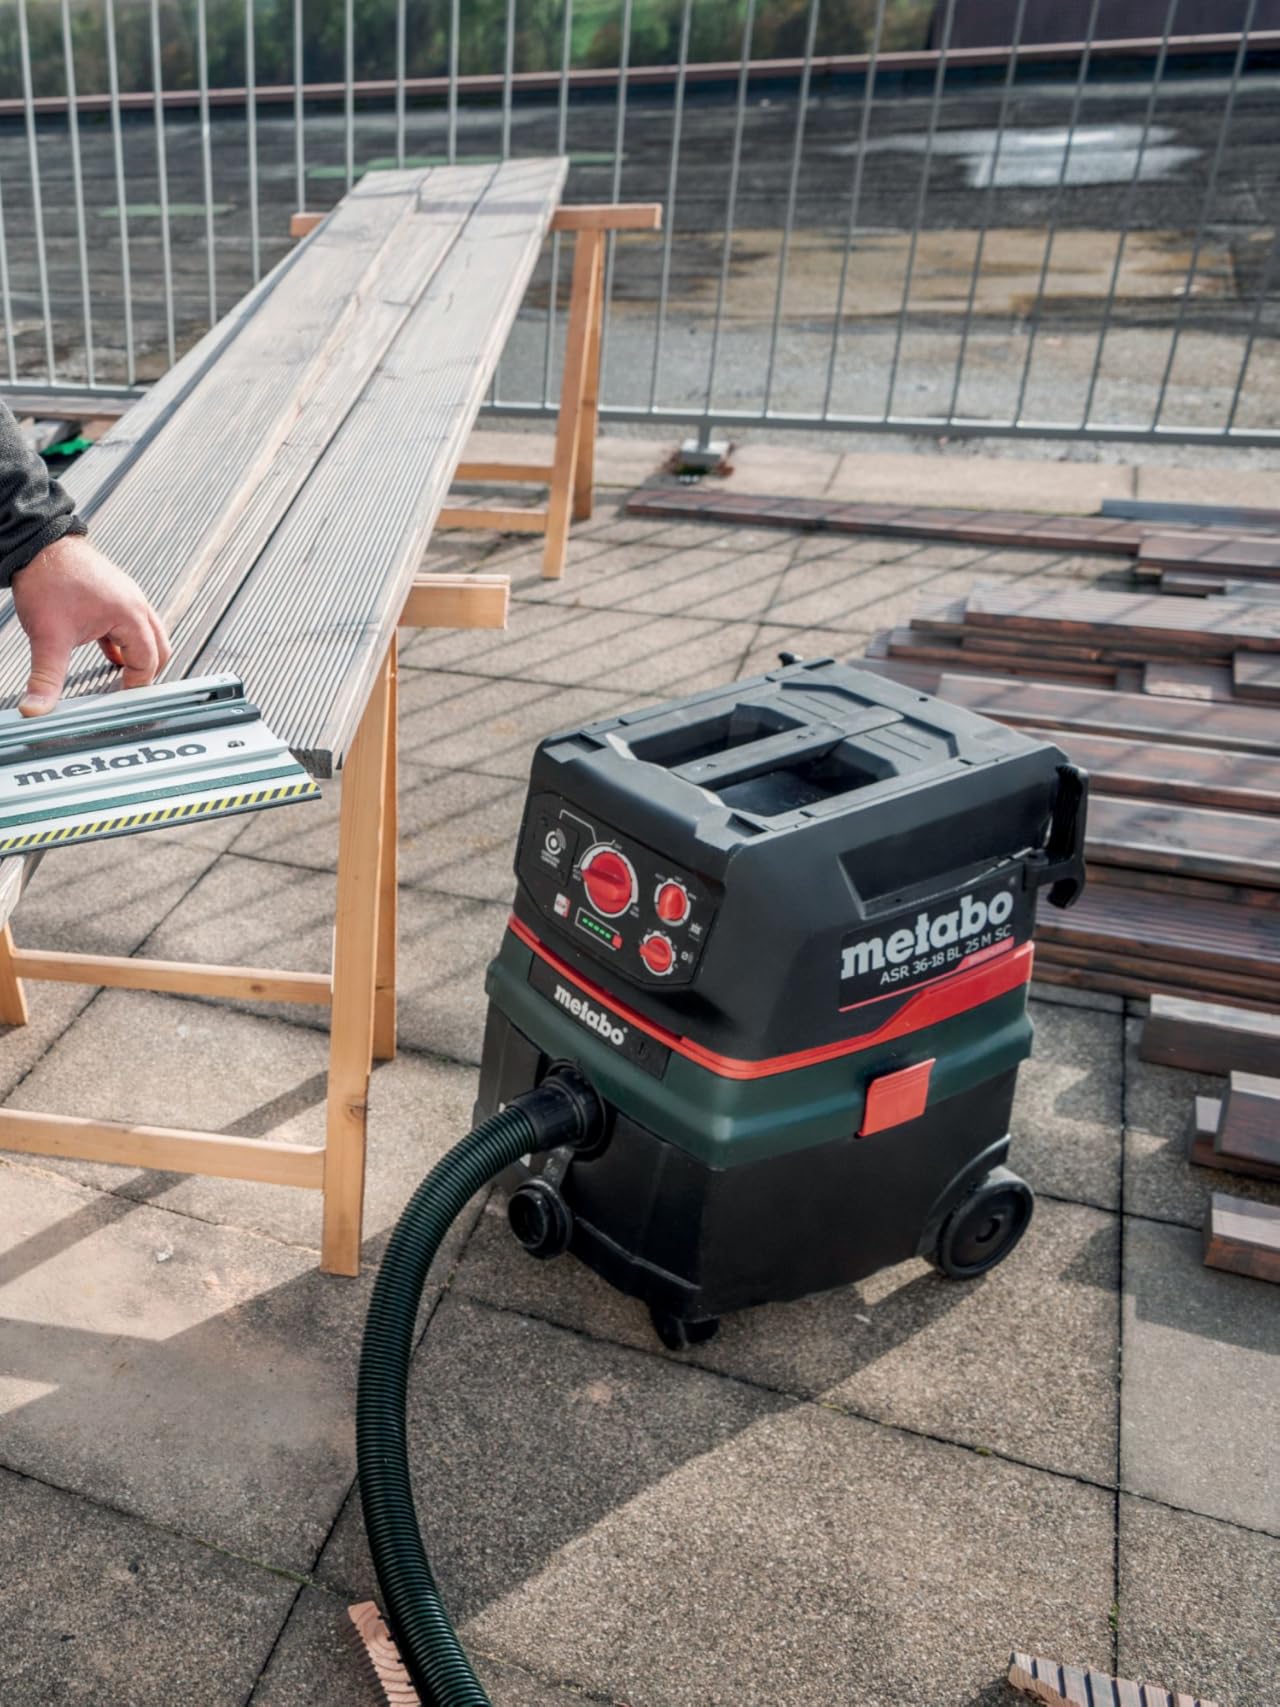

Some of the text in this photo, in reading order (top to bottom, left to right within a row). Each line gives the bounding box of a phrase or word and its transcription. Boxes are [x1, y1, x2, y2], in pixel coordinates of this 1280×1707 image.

[13, 743, 207, 787] metabo
[841, 891, 1014, 980] metabo
[880, 925, 1011, 985] ASR 36-18 BL 25 M SC
[554, 985, 625, 1045] metabo
